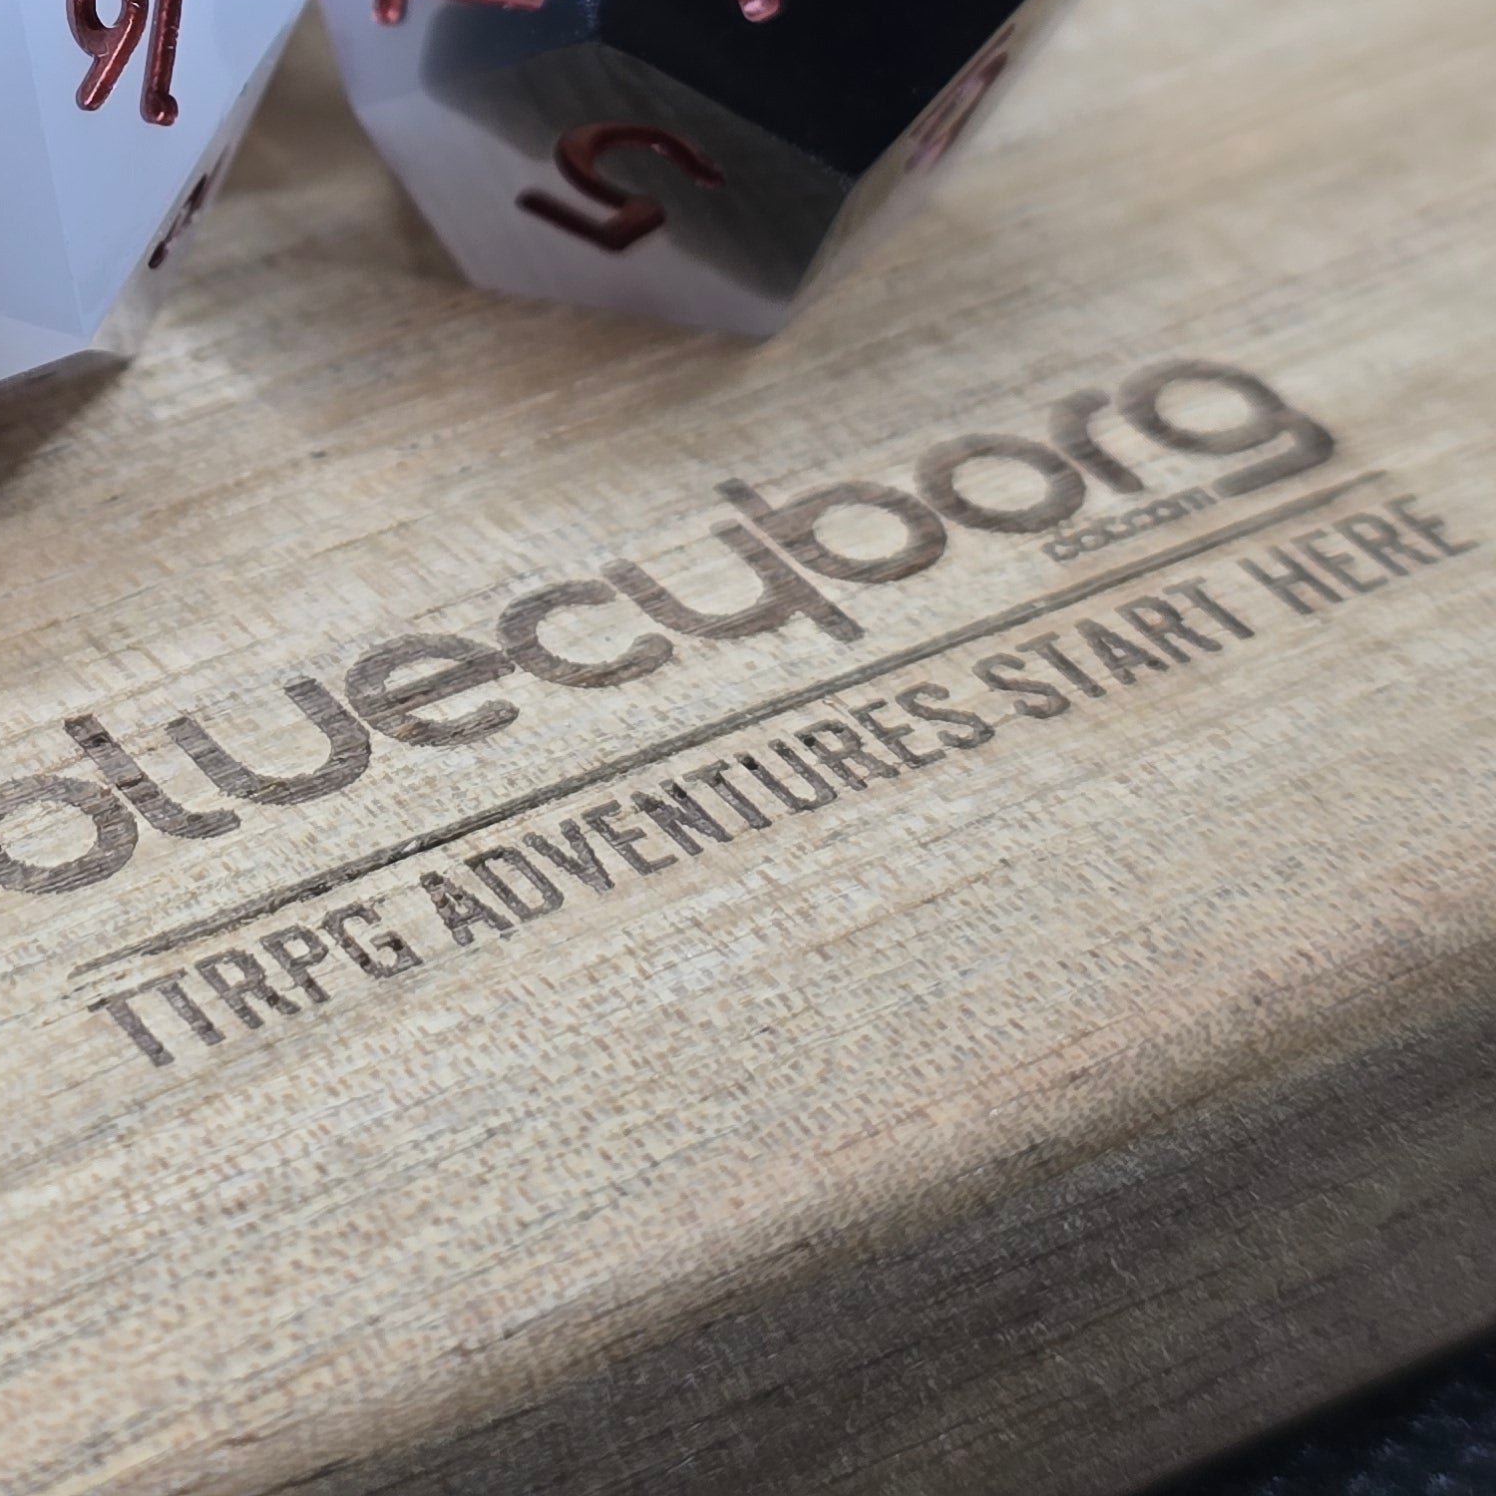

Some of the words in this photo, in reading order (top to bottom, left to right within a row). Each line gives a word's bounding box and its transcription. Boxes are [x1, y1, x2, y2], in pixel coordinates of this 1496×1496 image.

[516, 120, 725, 253] 5
[89, 898, 424, 1067] TTRPG
[419, 681, 995, 947] ADVENTURES
[971, 576, 1256, 722] START
[1239, 492, 1480, 615] HERE
